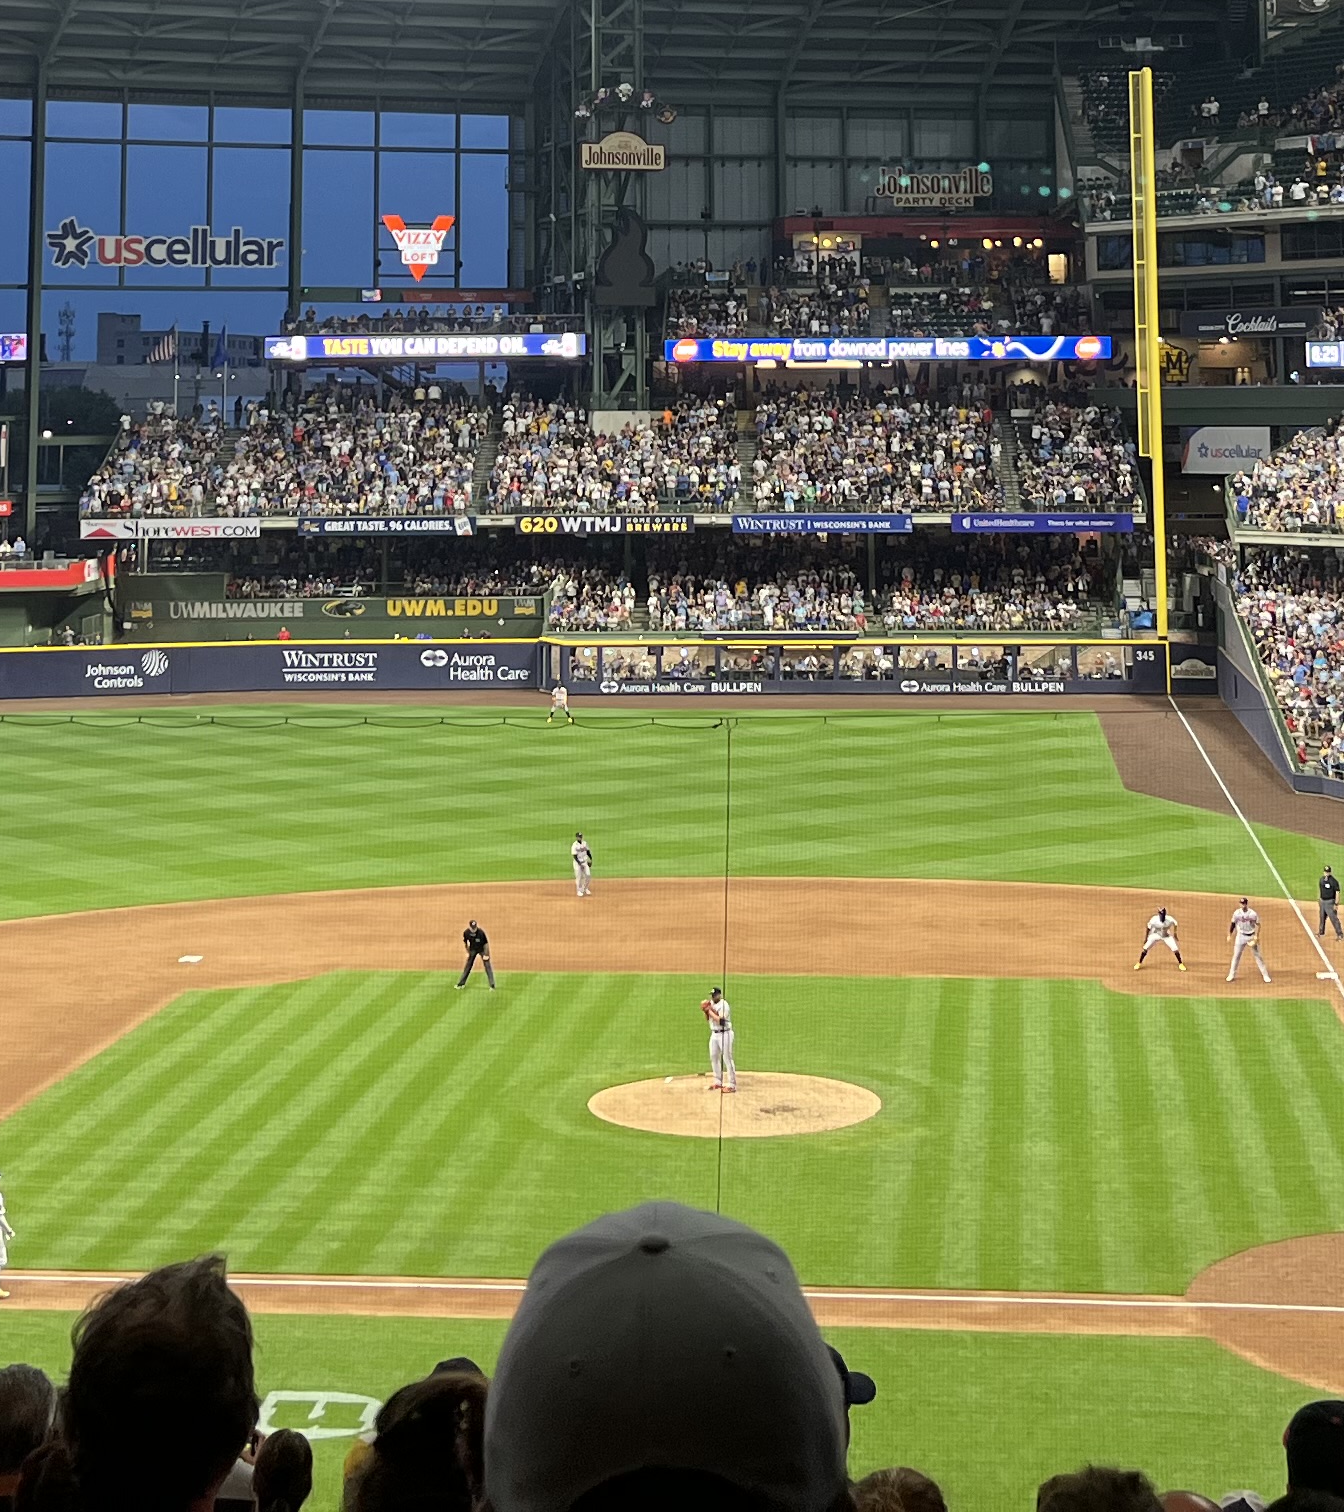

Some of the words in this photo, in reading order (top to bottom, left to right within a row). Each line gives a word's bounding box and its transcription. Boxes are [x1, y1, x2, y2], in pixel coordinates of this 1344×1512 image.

[585, 146, 661, 166] Johnsonville
[876, 167, 992, 196] Johnsonville
[896, 197, 935, 205] PARTY
[939, 197, 973, 206] DECK
[394, 232, 444, 245] VIZZY
[97, 226, 285, 268] uscellular
[404, 253, 436, 262] LOFT
[1226, 313, 1278, 334] Cocktails
[323, 338, 369, 355] TASTE
[370, 338, 404, 355] YOU
[405, 338, 435, 355] CAN
[438, 337, 498, 355] DEPEND
[712, 340, 749, 359] Stay
[750, 342, 792, 359] away
[793, 340, 827, 357] from
[829, 340, 886, 357] downed
[888, 341, 933, 359] power
[935, 339, 969, 356] lines
[1211, 445, 1263, 459] uscellular
[324, 518, 355, 531] GREAT
[356, 518, 388, 531] TASTE.
[390, 518, 402, 530] 96
[404, 518, 454, 531] CALORIES.
[521, 517, 558, 533] 620
[562, 516, 622, 533] WTMJ
[626, 523, 688, 532] BREWERS
[737, 517, 805, 530] WINTRUST
[813, 520, 866, 529] WISCONSIN'S
[868, 520, 891, 529] BANK
[169, 601, 303, 618] UWMILWAUKEE
[387, 599, 498, 617] UWM.EDU
[283, 651, 377, 667] WINTRUST
[450, 652, 496, 667] Aurora
[1136, 651, 1155, 661] 345
[85, 663, 135, 678] Johnson
[285, 673, 346, 682] WISCONSIN'S
[449, 666, 494, 682] Health
[497, 666, 528, 681] Care
[94, 675, 144, 688] Controls
[620, 682, 650, 694] Aurora
[652, 682, 682, 694] Health
[683, 682, 705, 693] Care
[711, 682, 762, 693] BULLPEN
[920, 682, 952, 694] Aurora
[953, 682, 984, 694] Health
[985, 682, 1006, 693] Care
[1013, 682, 1064, 693] BULLPEN
